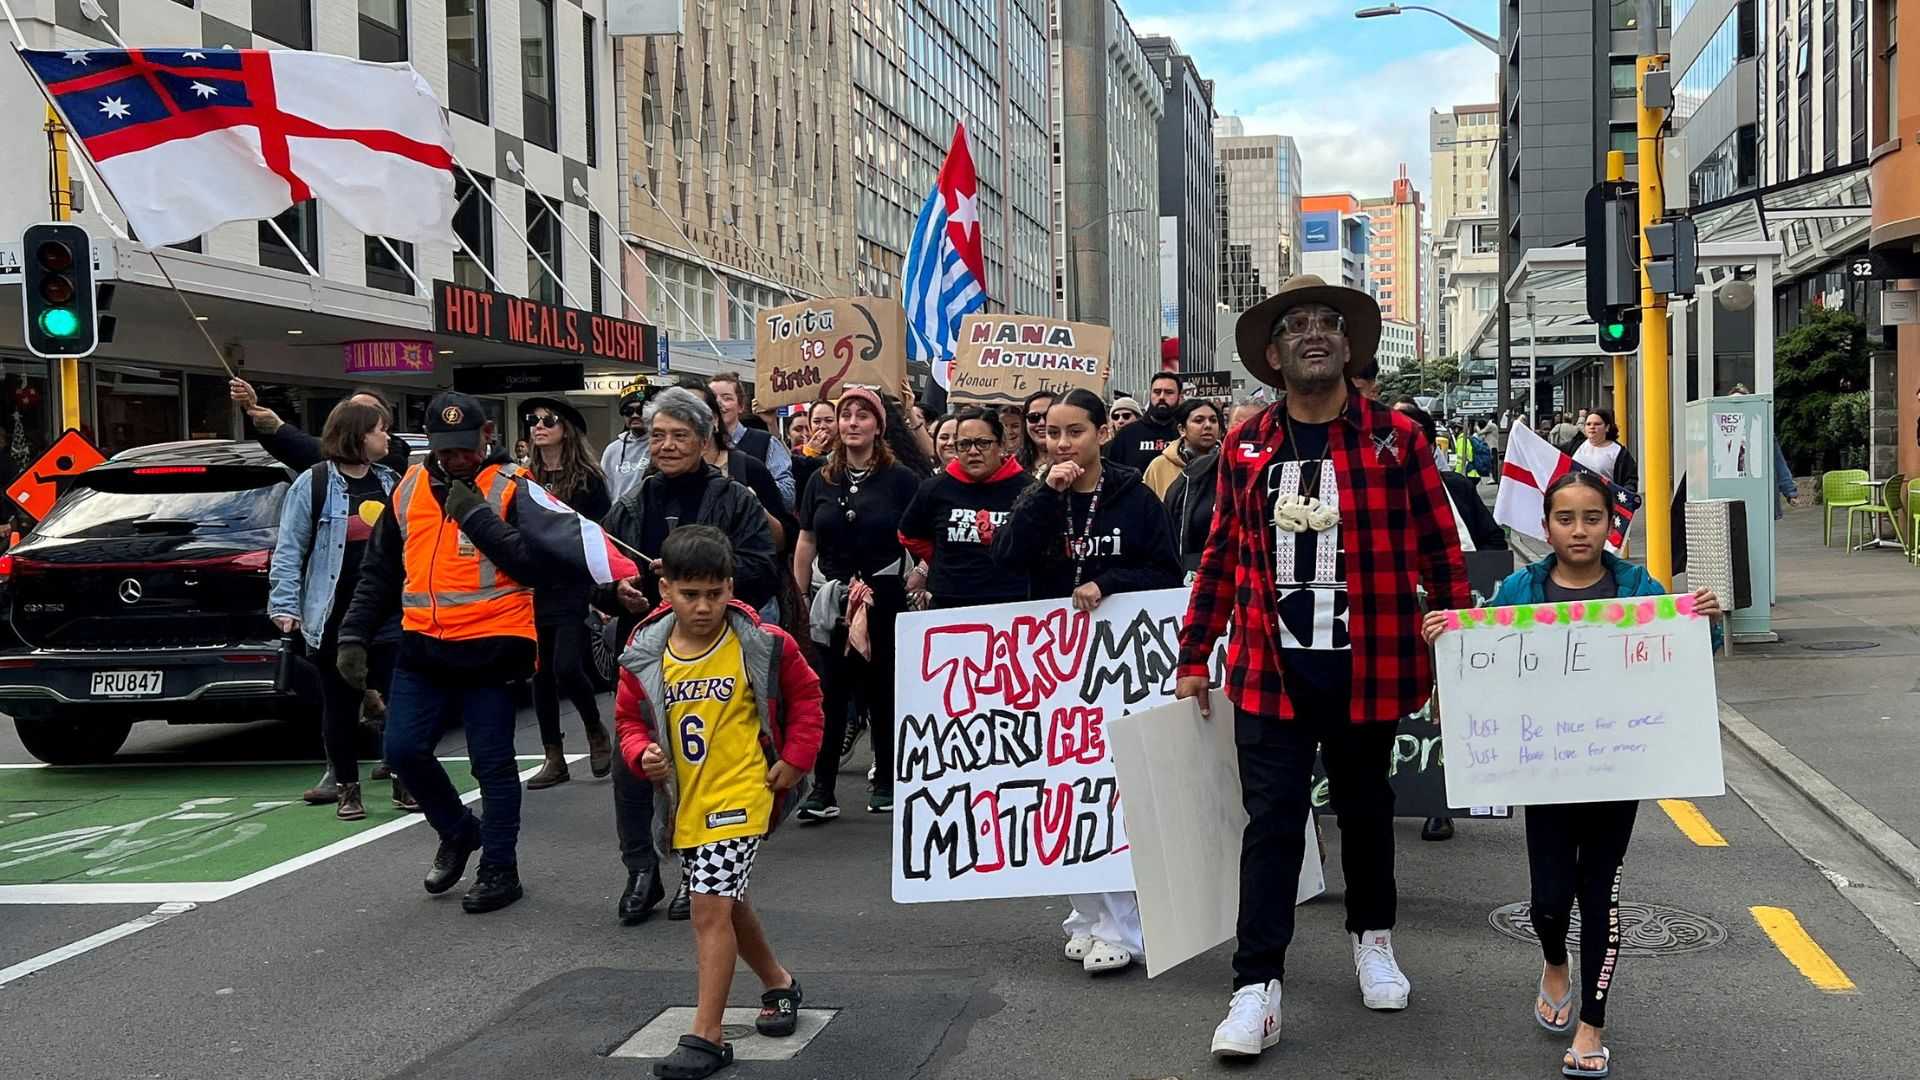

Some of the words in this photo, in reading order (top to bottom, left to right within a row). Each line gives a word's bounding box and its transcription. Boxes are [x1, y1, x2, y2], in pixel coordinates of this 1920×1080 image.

[1852, 263, 1872, 276] 32
[446, 285, 493, 337] HOT
[507, 298, 585, 354] MEALS,
[591, 316, 644, 362] SUSHI
[970, 323, 1074, 347] MANA
[800, 338, 826, 361] te
[954, 372, 999, 388] Honour
[1011, 374, 1027, 390] Te
[93, 673, 160, 693] PRU847
[664, 677, 737, 711] AKERS
[679, 713, 708, 765] 6
[1520, 714, 1544, 741] Be
[902, 777, 1130, 881] MOTUH
[1609, 908, 1619, 943] DAYS
[1597, 948, 1617, 990] AHEAD
